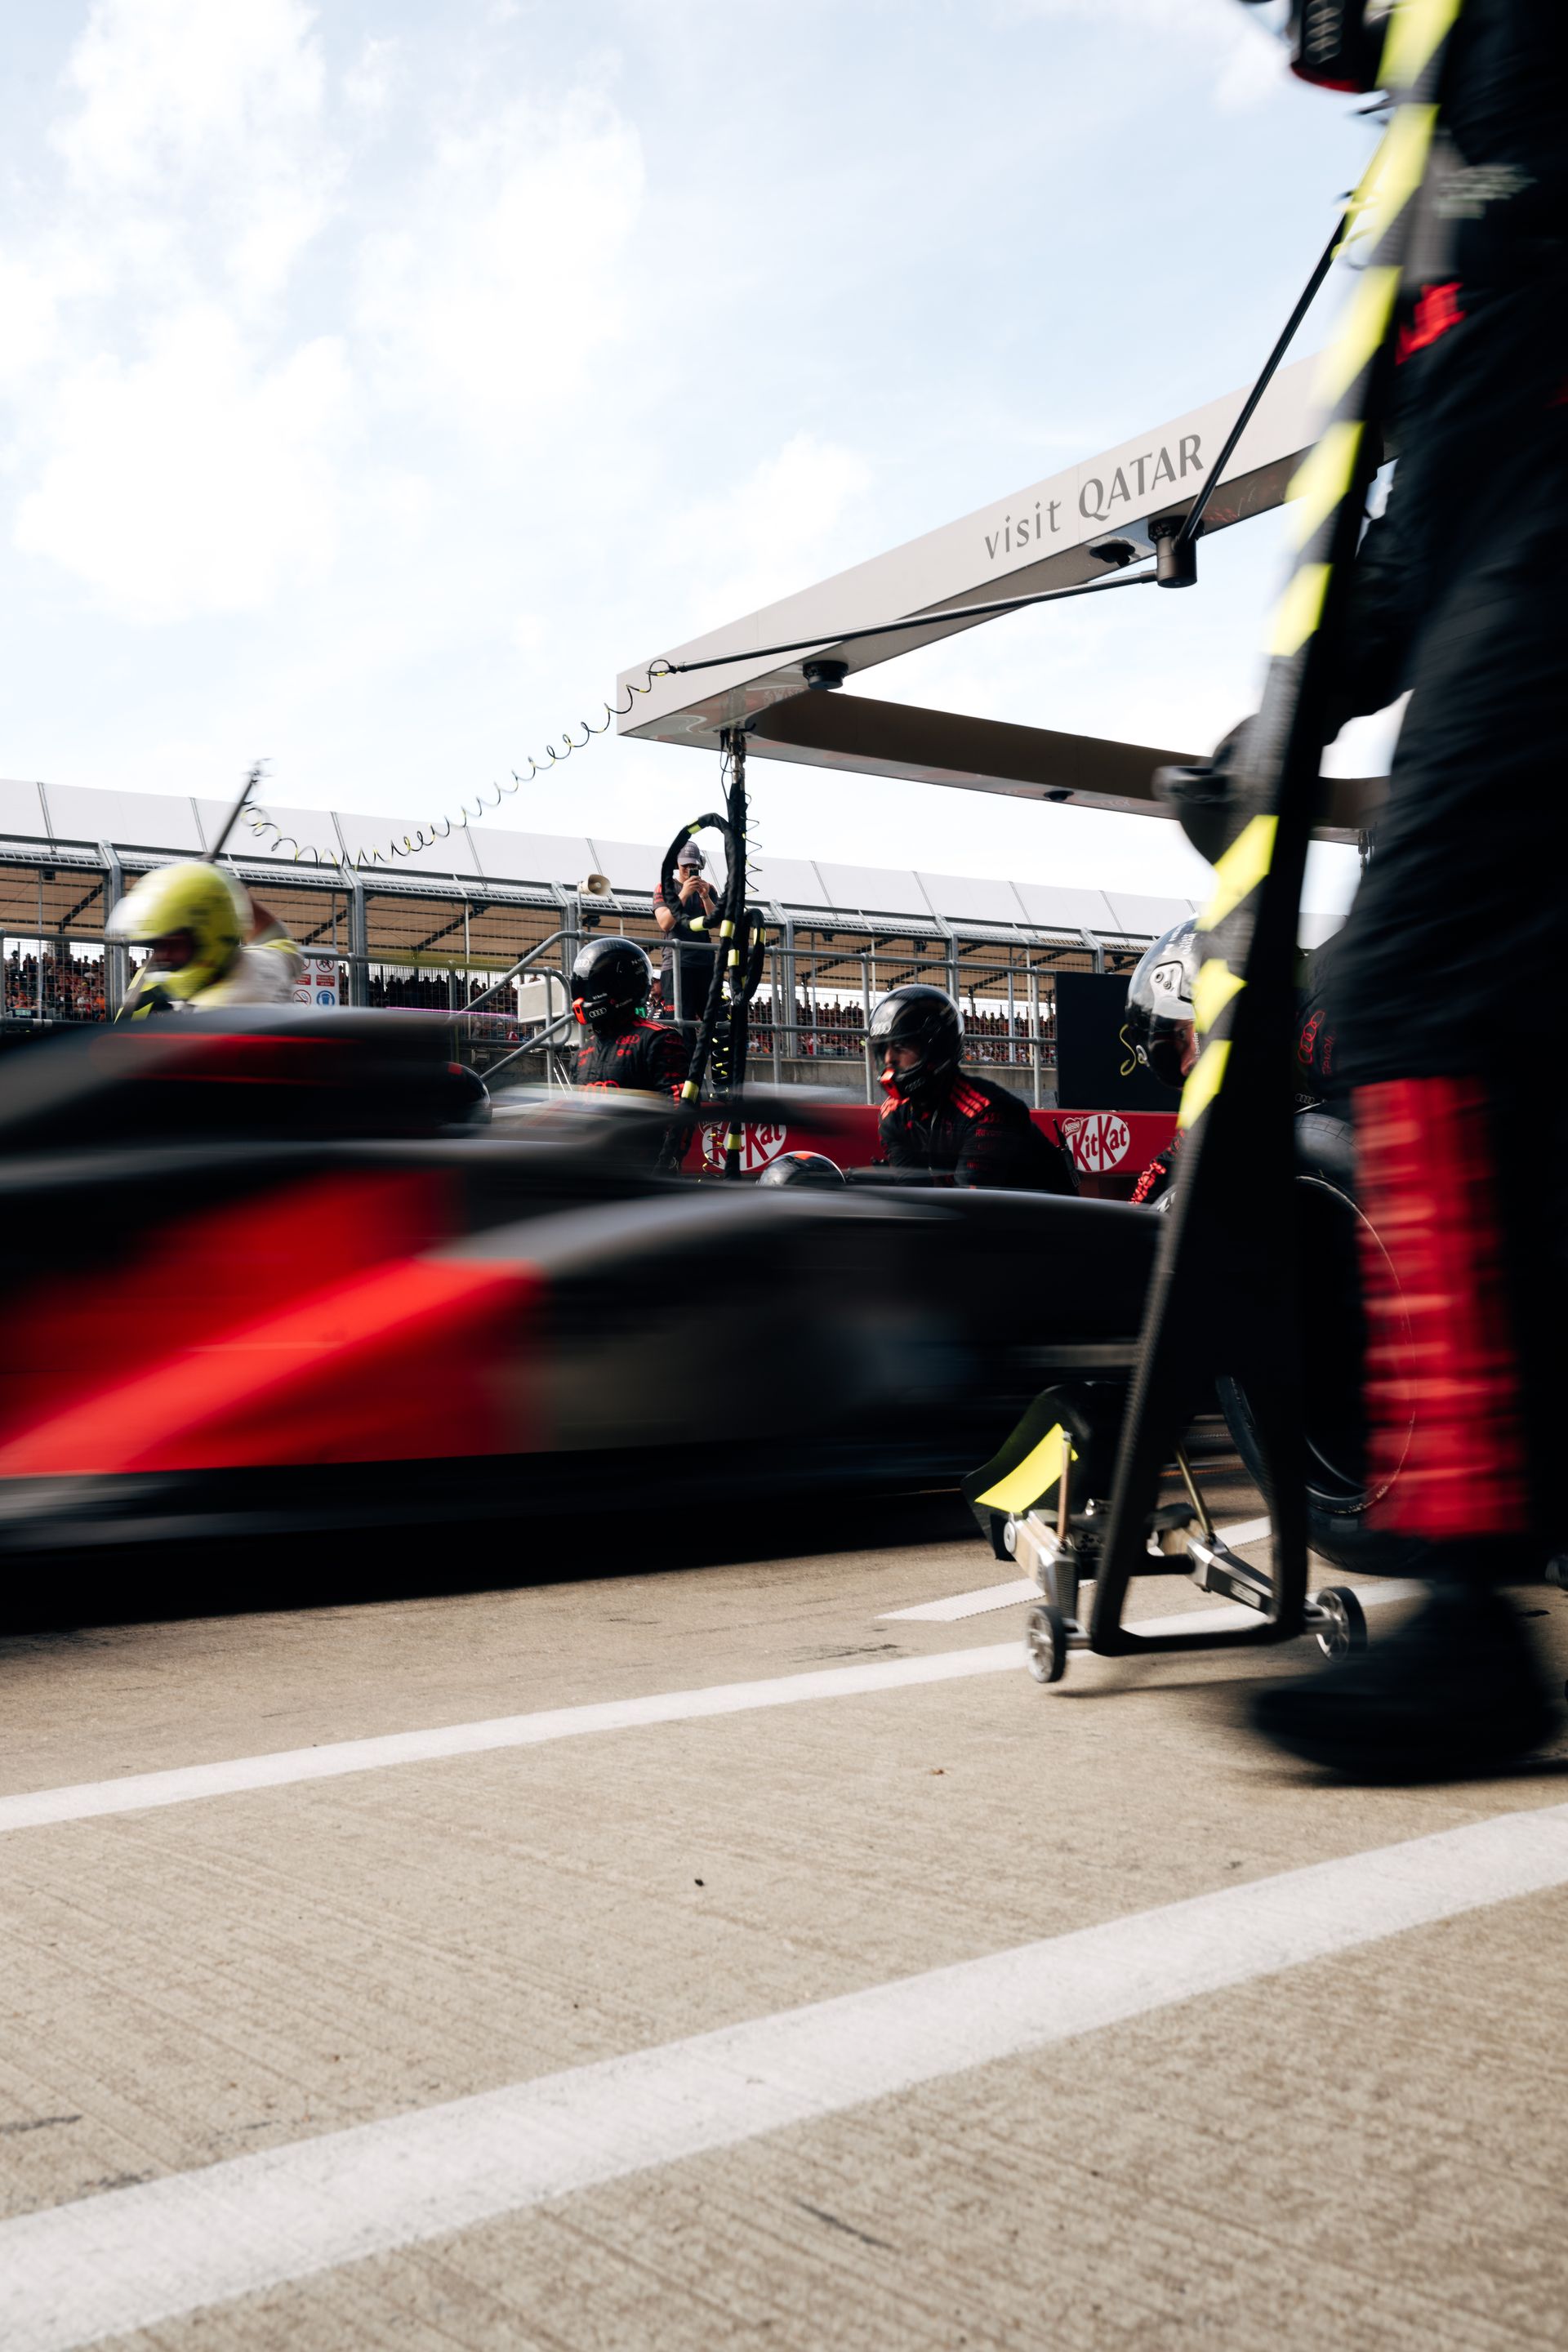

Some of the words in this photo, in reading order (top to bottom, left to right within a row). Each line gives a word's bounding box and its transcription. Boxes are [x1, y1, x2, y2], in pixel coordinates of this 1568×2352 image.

[984, 499, 1062, 559] visit
[1078, 433, 1205, 522] QATAR
[1072, 1116, 1127, 1172] KitKat
